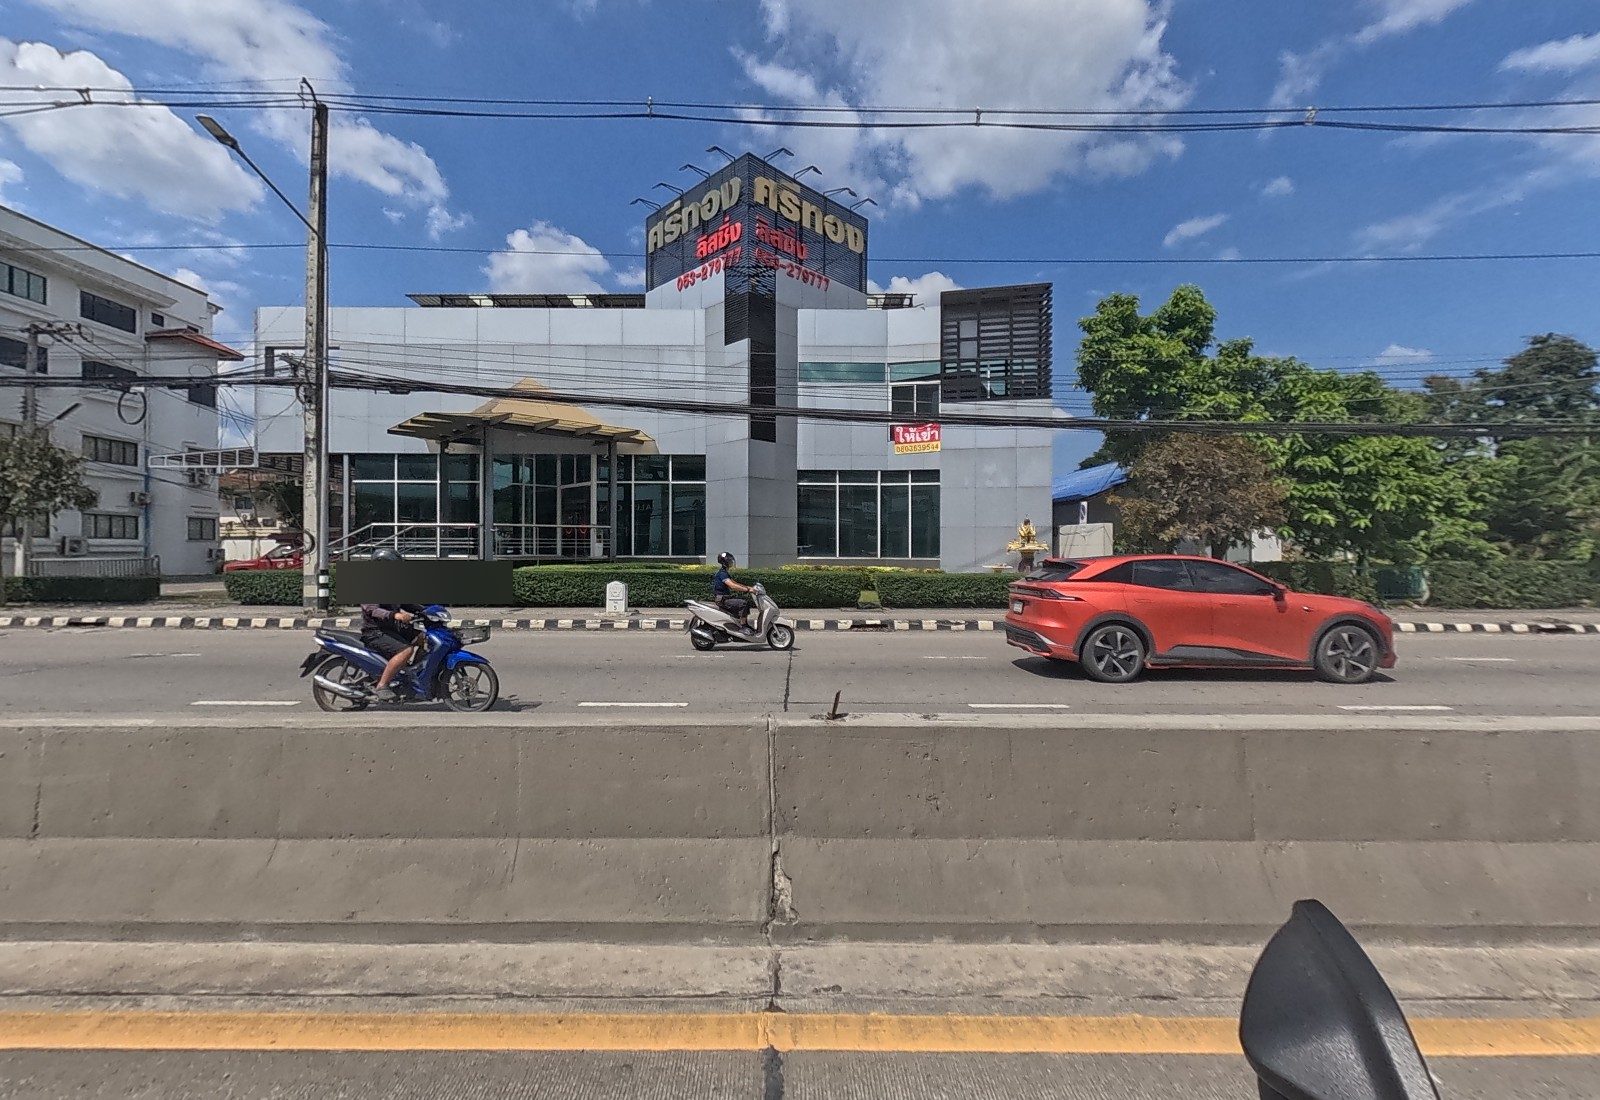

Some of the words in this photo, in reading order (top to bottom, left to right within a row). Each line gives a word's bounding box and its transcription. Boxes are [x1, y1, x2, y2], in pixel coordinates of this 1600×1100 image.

[648, 176, 741, 254] ศรีทอง
[754, 176, 864, 254] ศรีทอง
[896, 423, 939, 442] ให้เช่า
[896, 443, 939, 453] 0803639544
